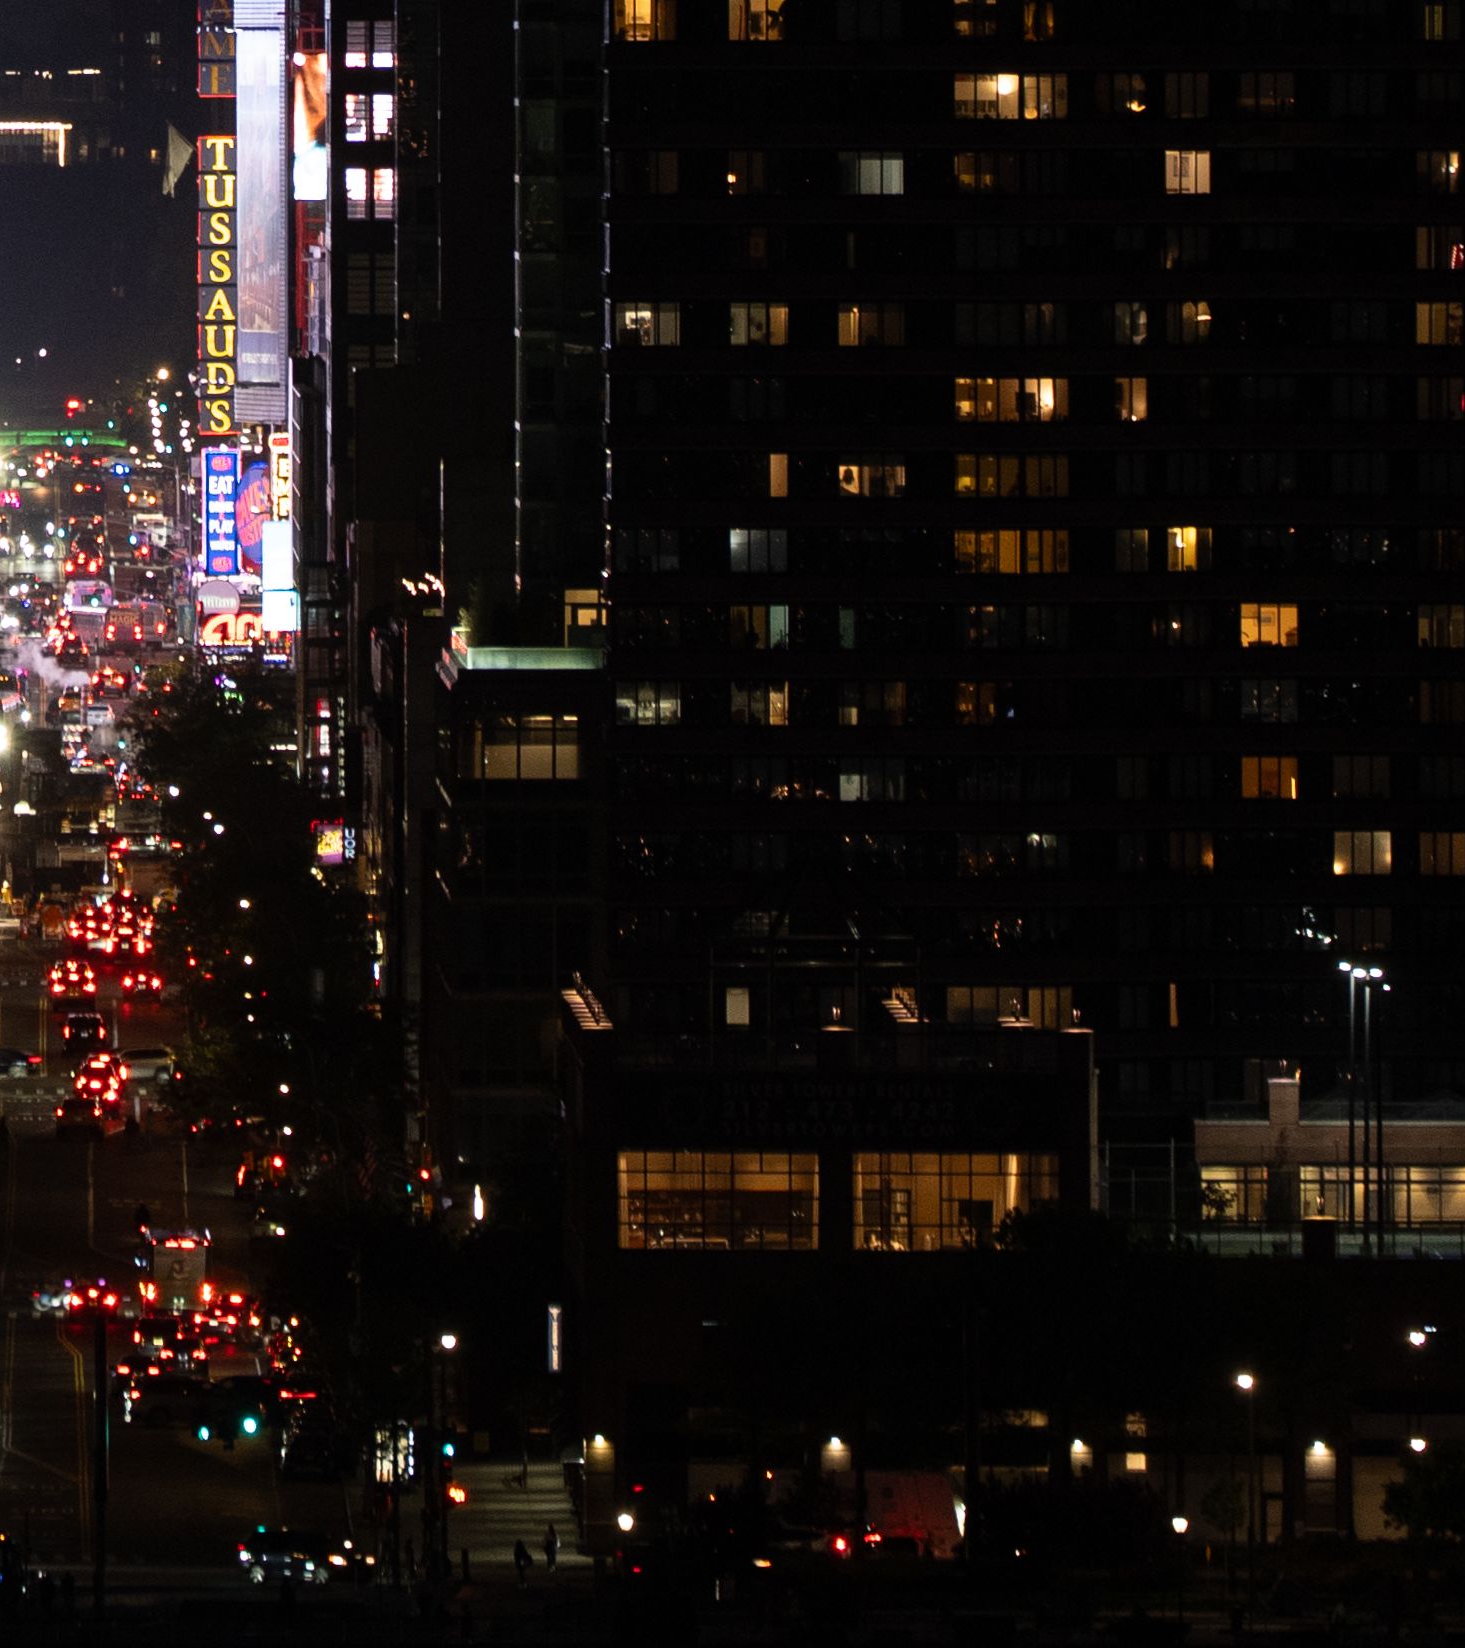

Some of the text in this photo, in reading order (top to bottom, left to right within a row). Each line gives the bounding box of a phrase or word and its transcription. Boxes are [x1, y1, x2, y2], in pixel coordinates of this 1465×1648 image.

[204, 138, 237, 433] TUSSAUD'S
[208, 475, 235, 495] EAT
[208, 519, 235, 534] PLAY
